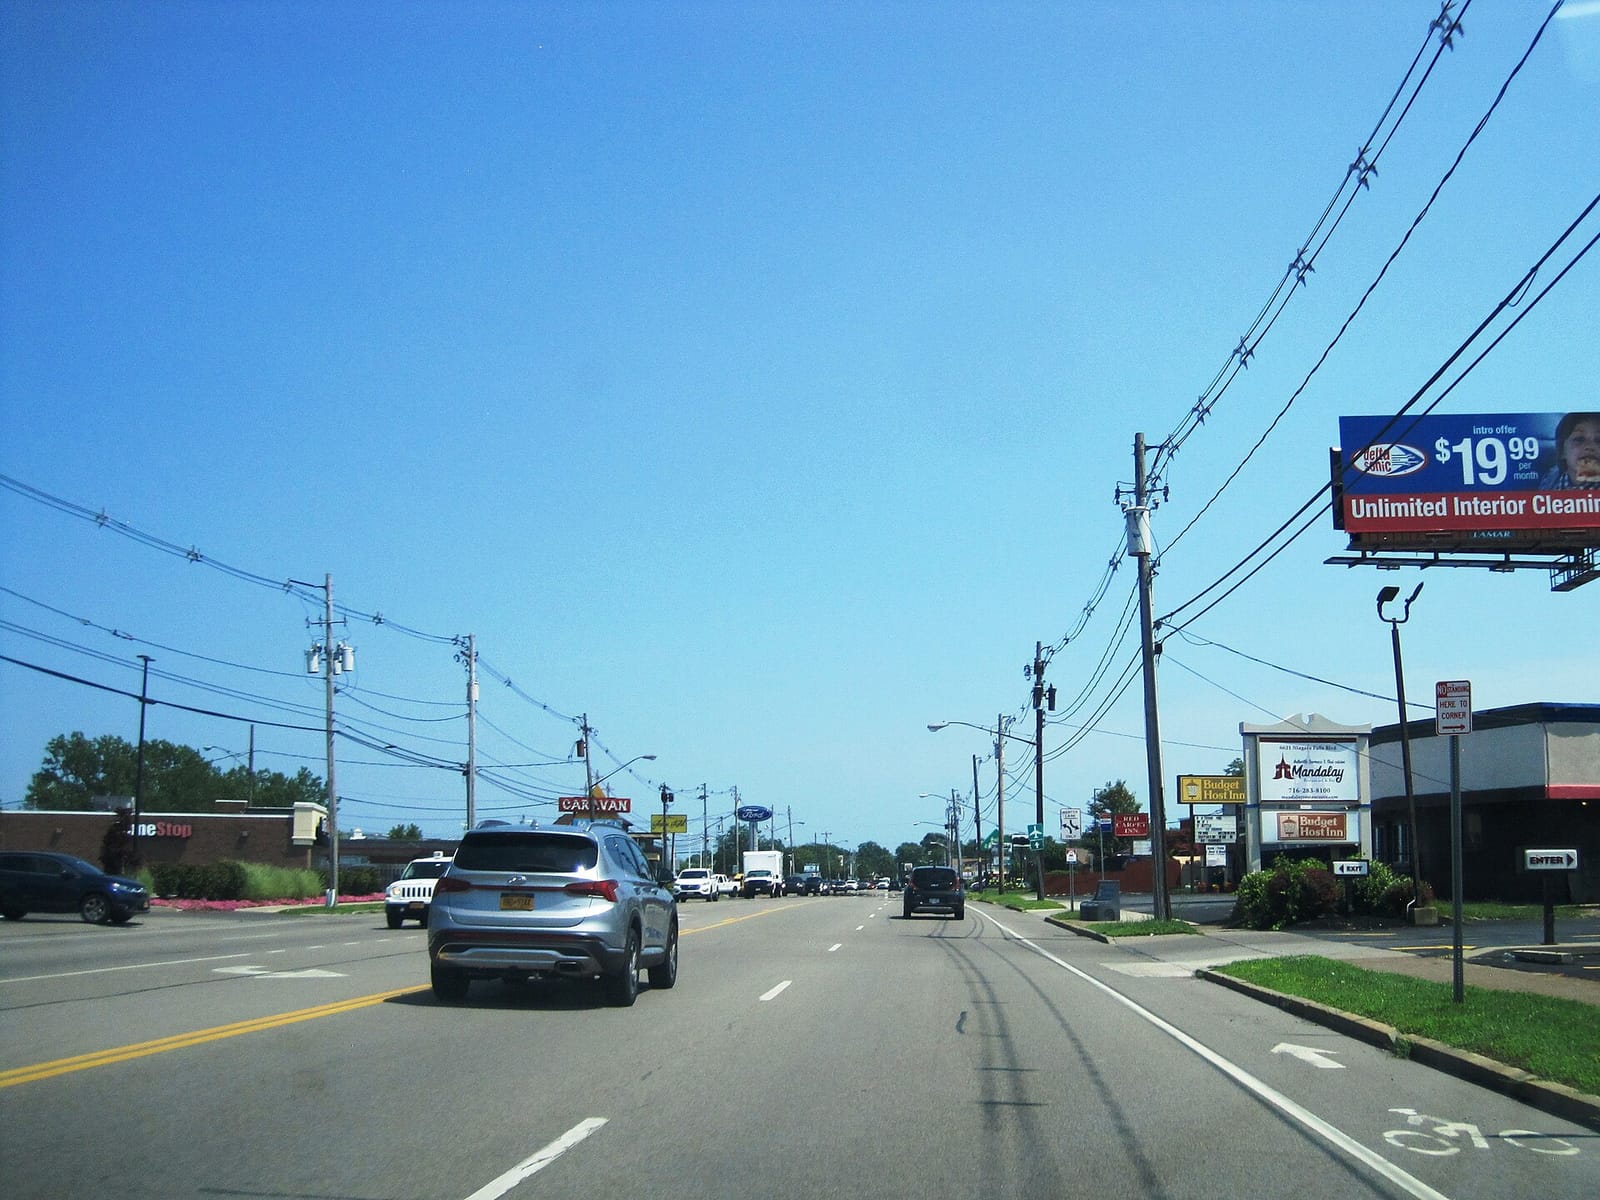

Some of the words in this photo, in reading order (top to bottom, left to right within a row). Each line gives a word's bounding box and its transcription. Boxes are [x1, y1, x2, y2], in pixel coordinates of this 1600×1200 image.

[1473, 425, 1494, 435] intro
[1496, 425, 1517, 435] offer
[1364, 447, 1390, 460] delta
[1364, 460, 1392, 472] sonic
[1519, 462, 1532, 470] per
[1513, 471, 1539, 480] month
[1351, 497, 1447, 519] Unlimited
[1454, 495, 1527, 516] Interior
[1442, 712, 1466, 720] CORNER
[1292, 764, 1344, 783] Mandalay
[1203, 779, 1239, 791] Budget
[1203, 790, 1227, 800] Host
[1229, 790, 1245, 800] Inn
[562, 799, 628, 812] CARVAN
[1300, 815, 1337, 828] Budget
[1300, 827, 1324, 837] Host
[1326, 827, 1344, 837] Inn
[1530, 856, 1563, 864] ENTER
[1347, 865, 1362, 873] EXIT
